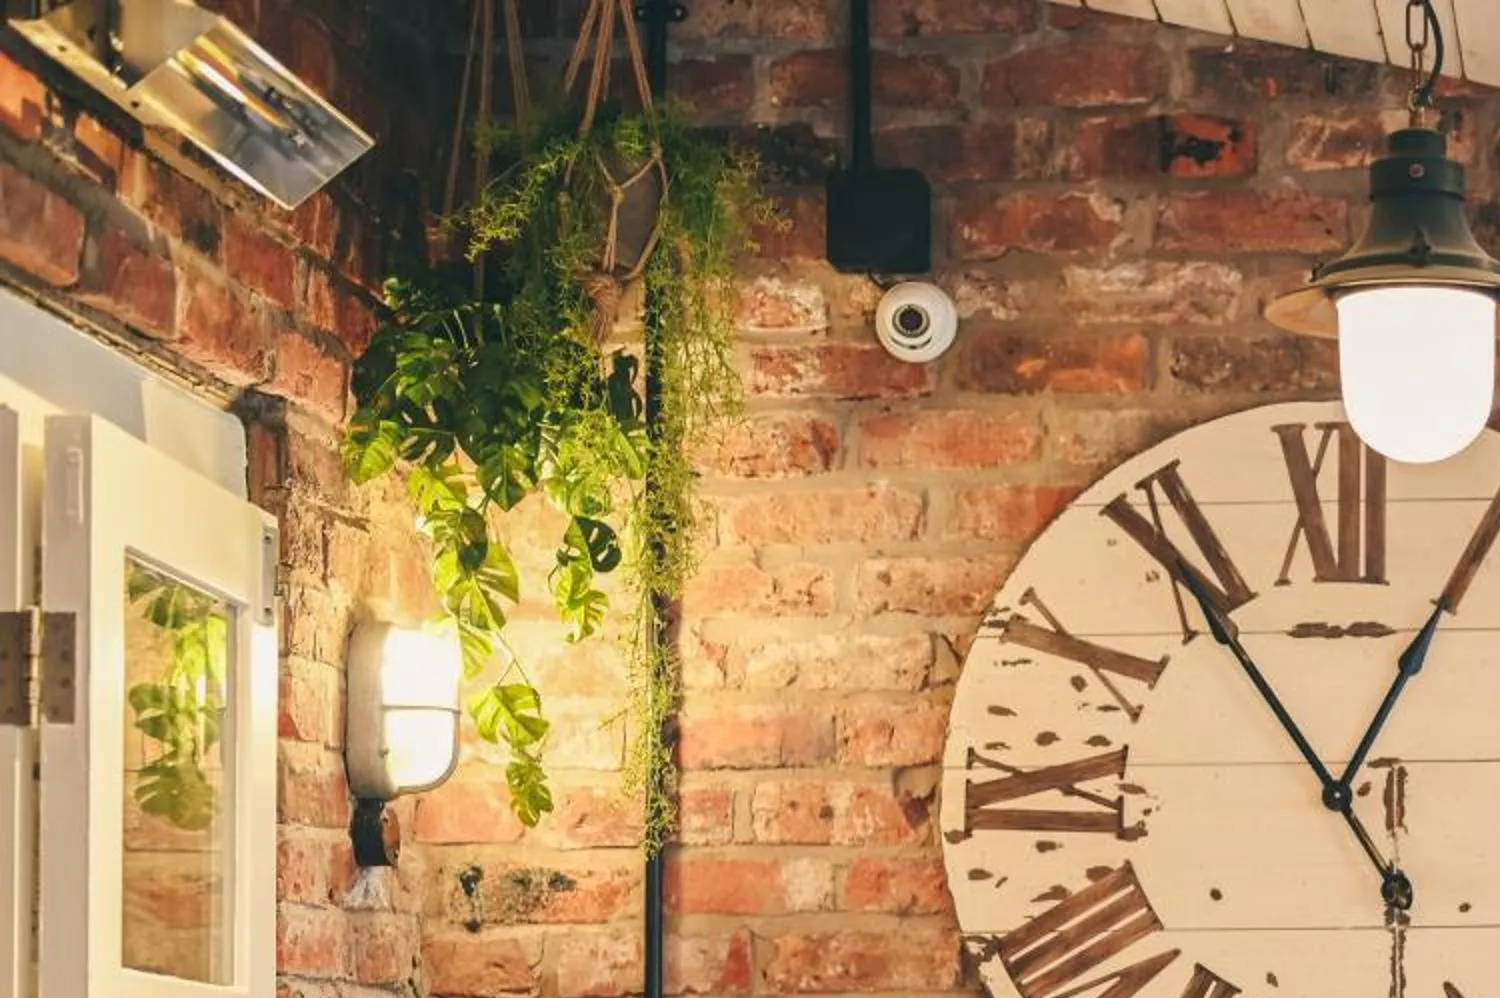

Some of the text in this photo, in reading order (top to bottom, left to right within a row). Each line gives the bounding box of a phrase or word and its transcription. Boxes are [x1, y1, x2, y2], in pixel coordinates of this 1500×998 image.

[1099, 460, 1258, 643] XI
[1272, 422, 1390, 586] XII
[1000, 588, 1170, 722] X
[964, 745, 1128, 838] IX
